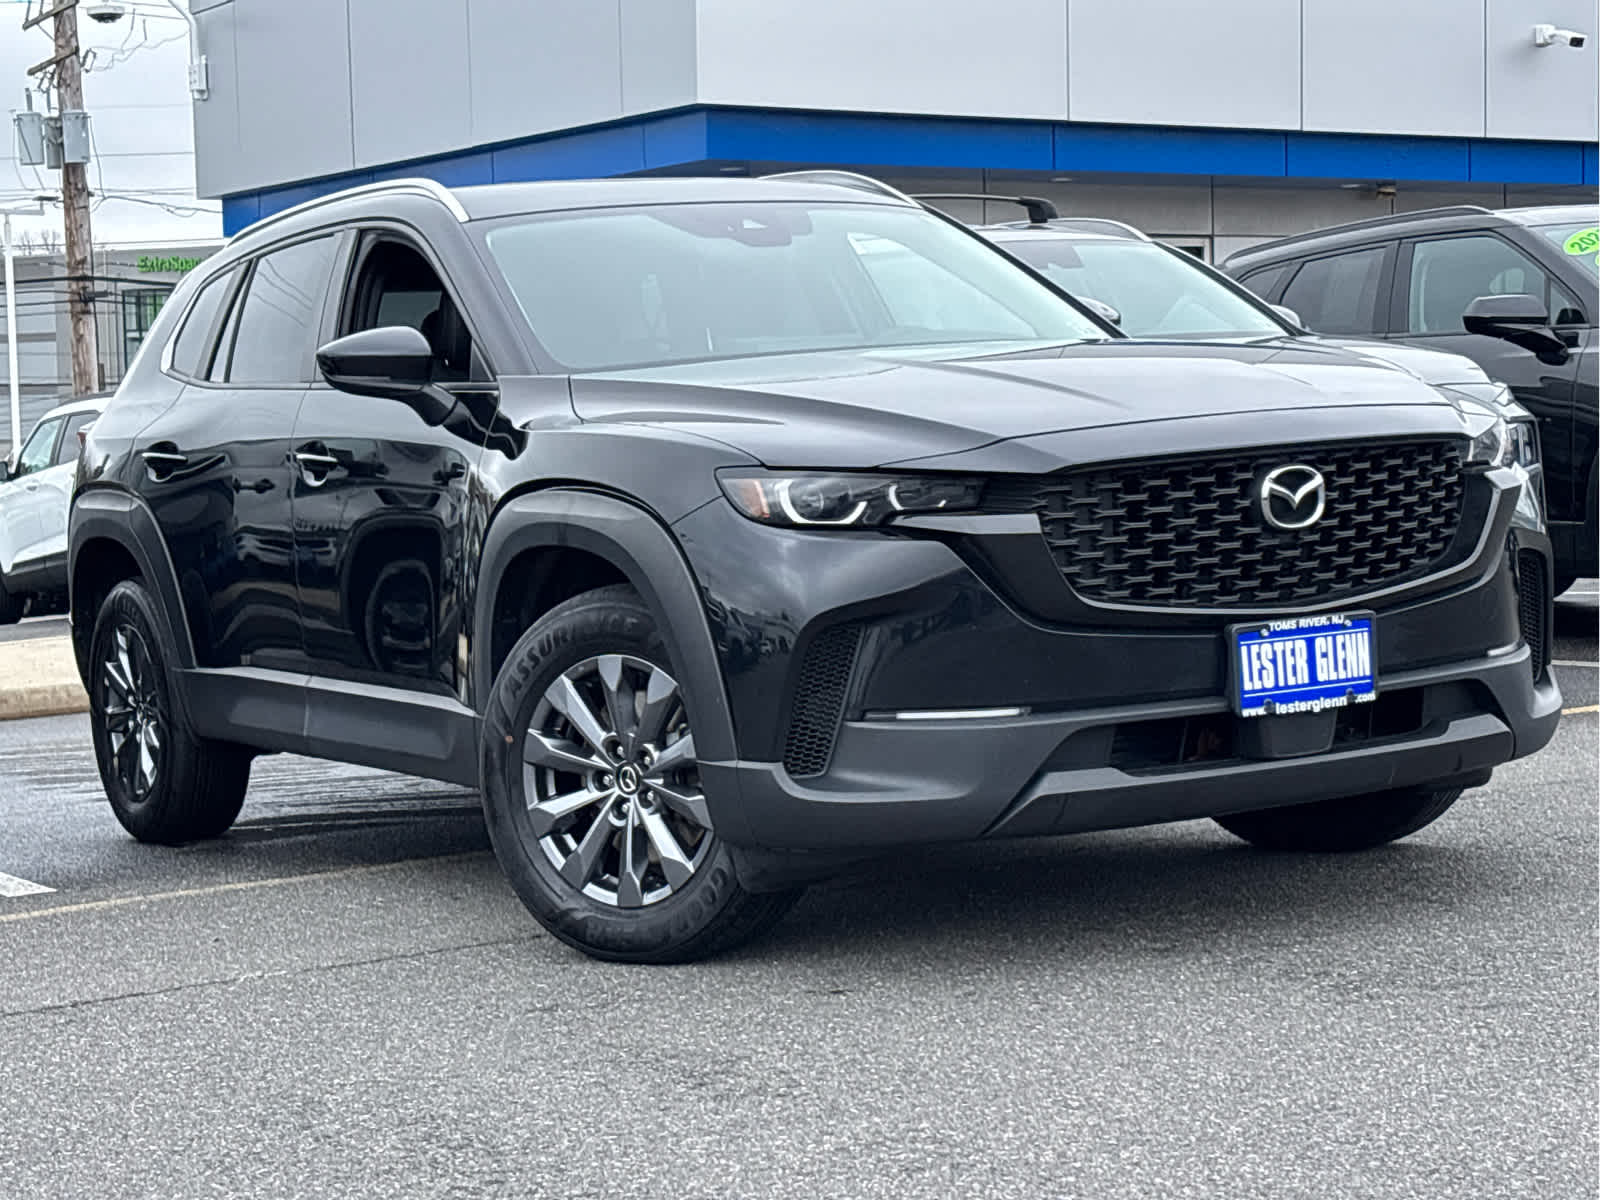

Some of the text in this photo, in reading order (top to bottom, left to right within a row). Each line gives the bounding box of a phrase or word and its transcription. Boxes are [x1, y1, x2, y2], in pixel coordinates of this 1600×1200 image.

[1570, 229, 1598, 252] 202
[1270, 618, 1297, 631] TOMS
[1332, 614, 1345, 625] NJ
[504, 613, 639, 699] ASSURCE
[1241, 631, 1371, 691] LESTER GLENN
